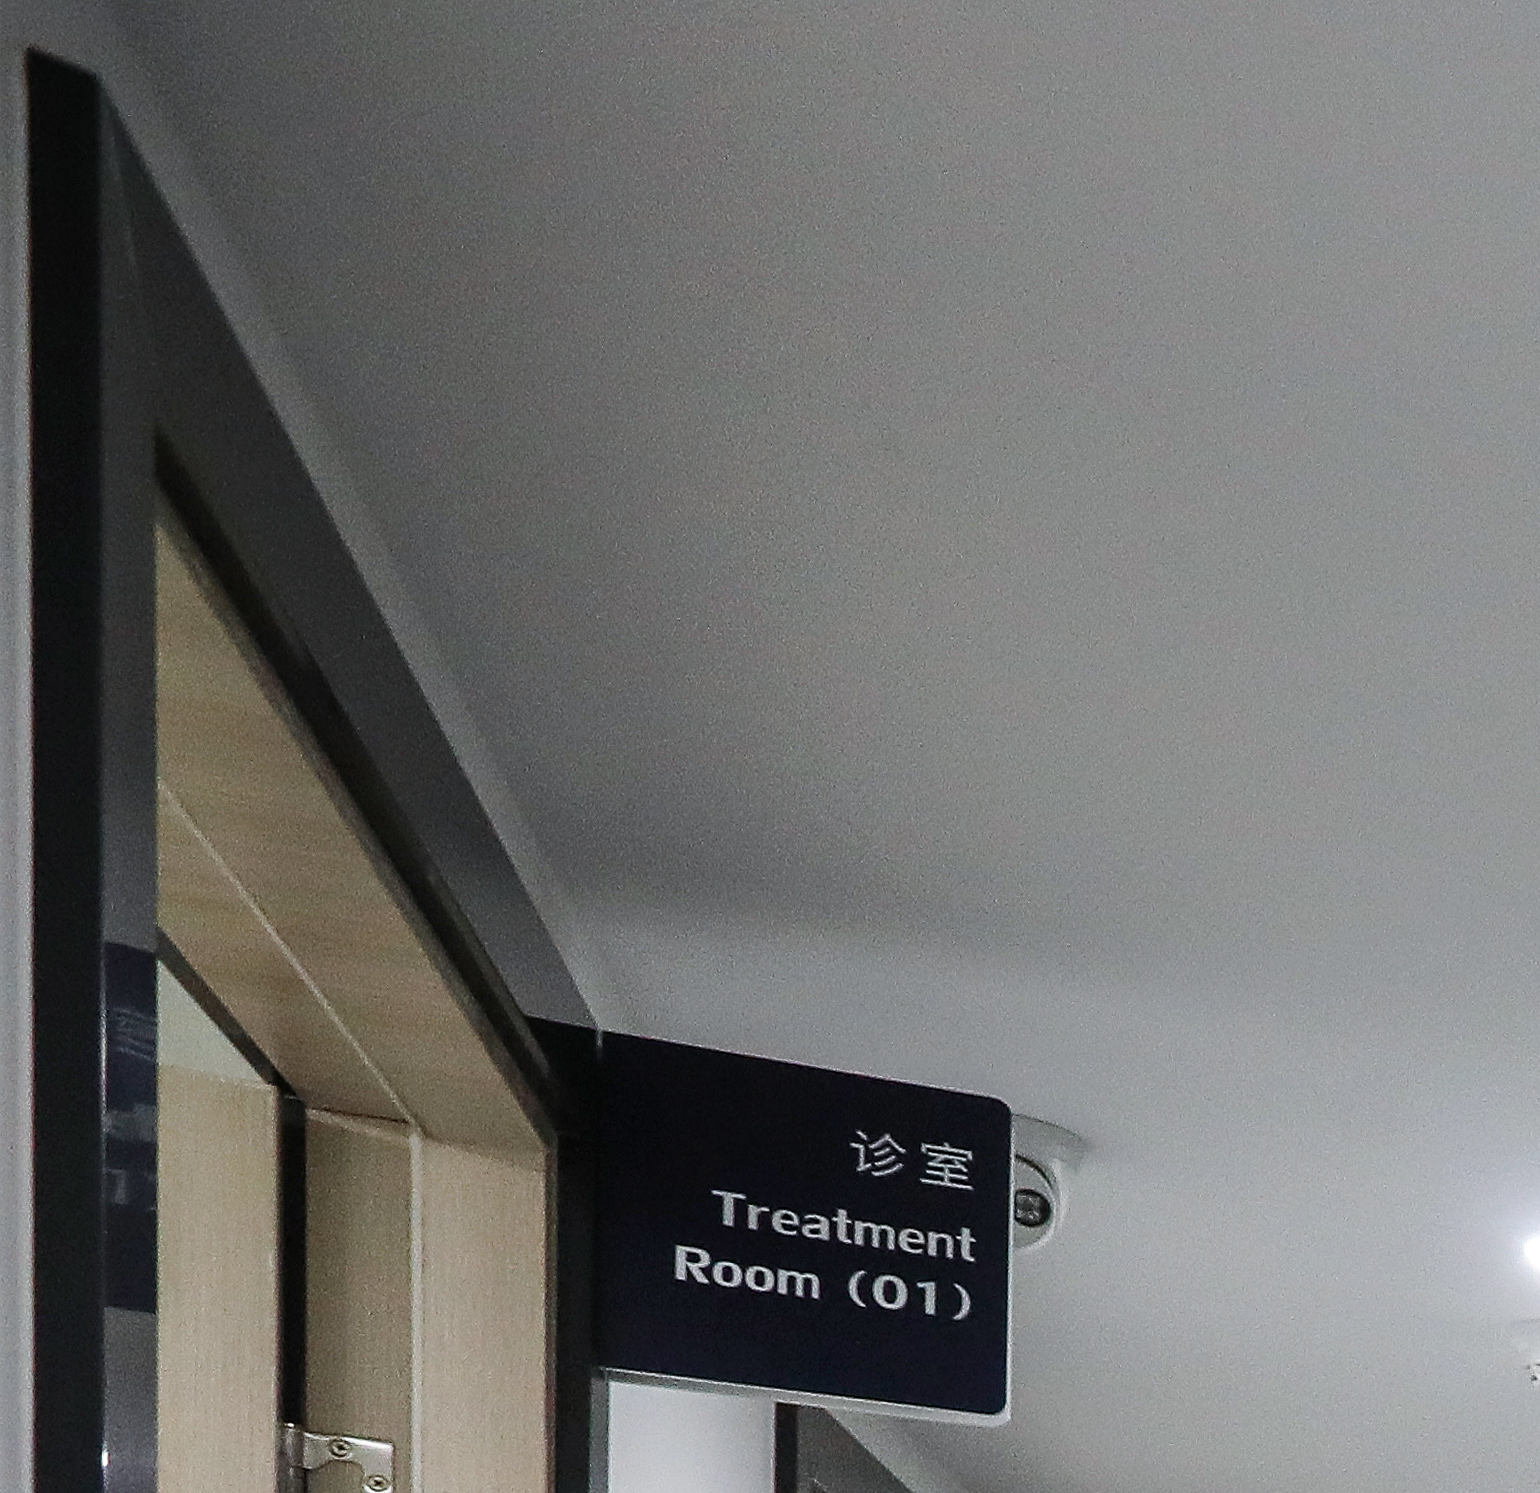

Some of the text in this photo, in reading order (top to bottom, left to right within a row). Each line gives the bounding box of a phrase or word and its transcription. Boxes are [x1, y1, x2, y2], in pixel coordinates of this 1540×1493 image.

[849, 1129, 975, 1192] 诊室
[711, 1189, 977, 1263] Treatment
[674, 1245, 972, 1321] Room (01)
